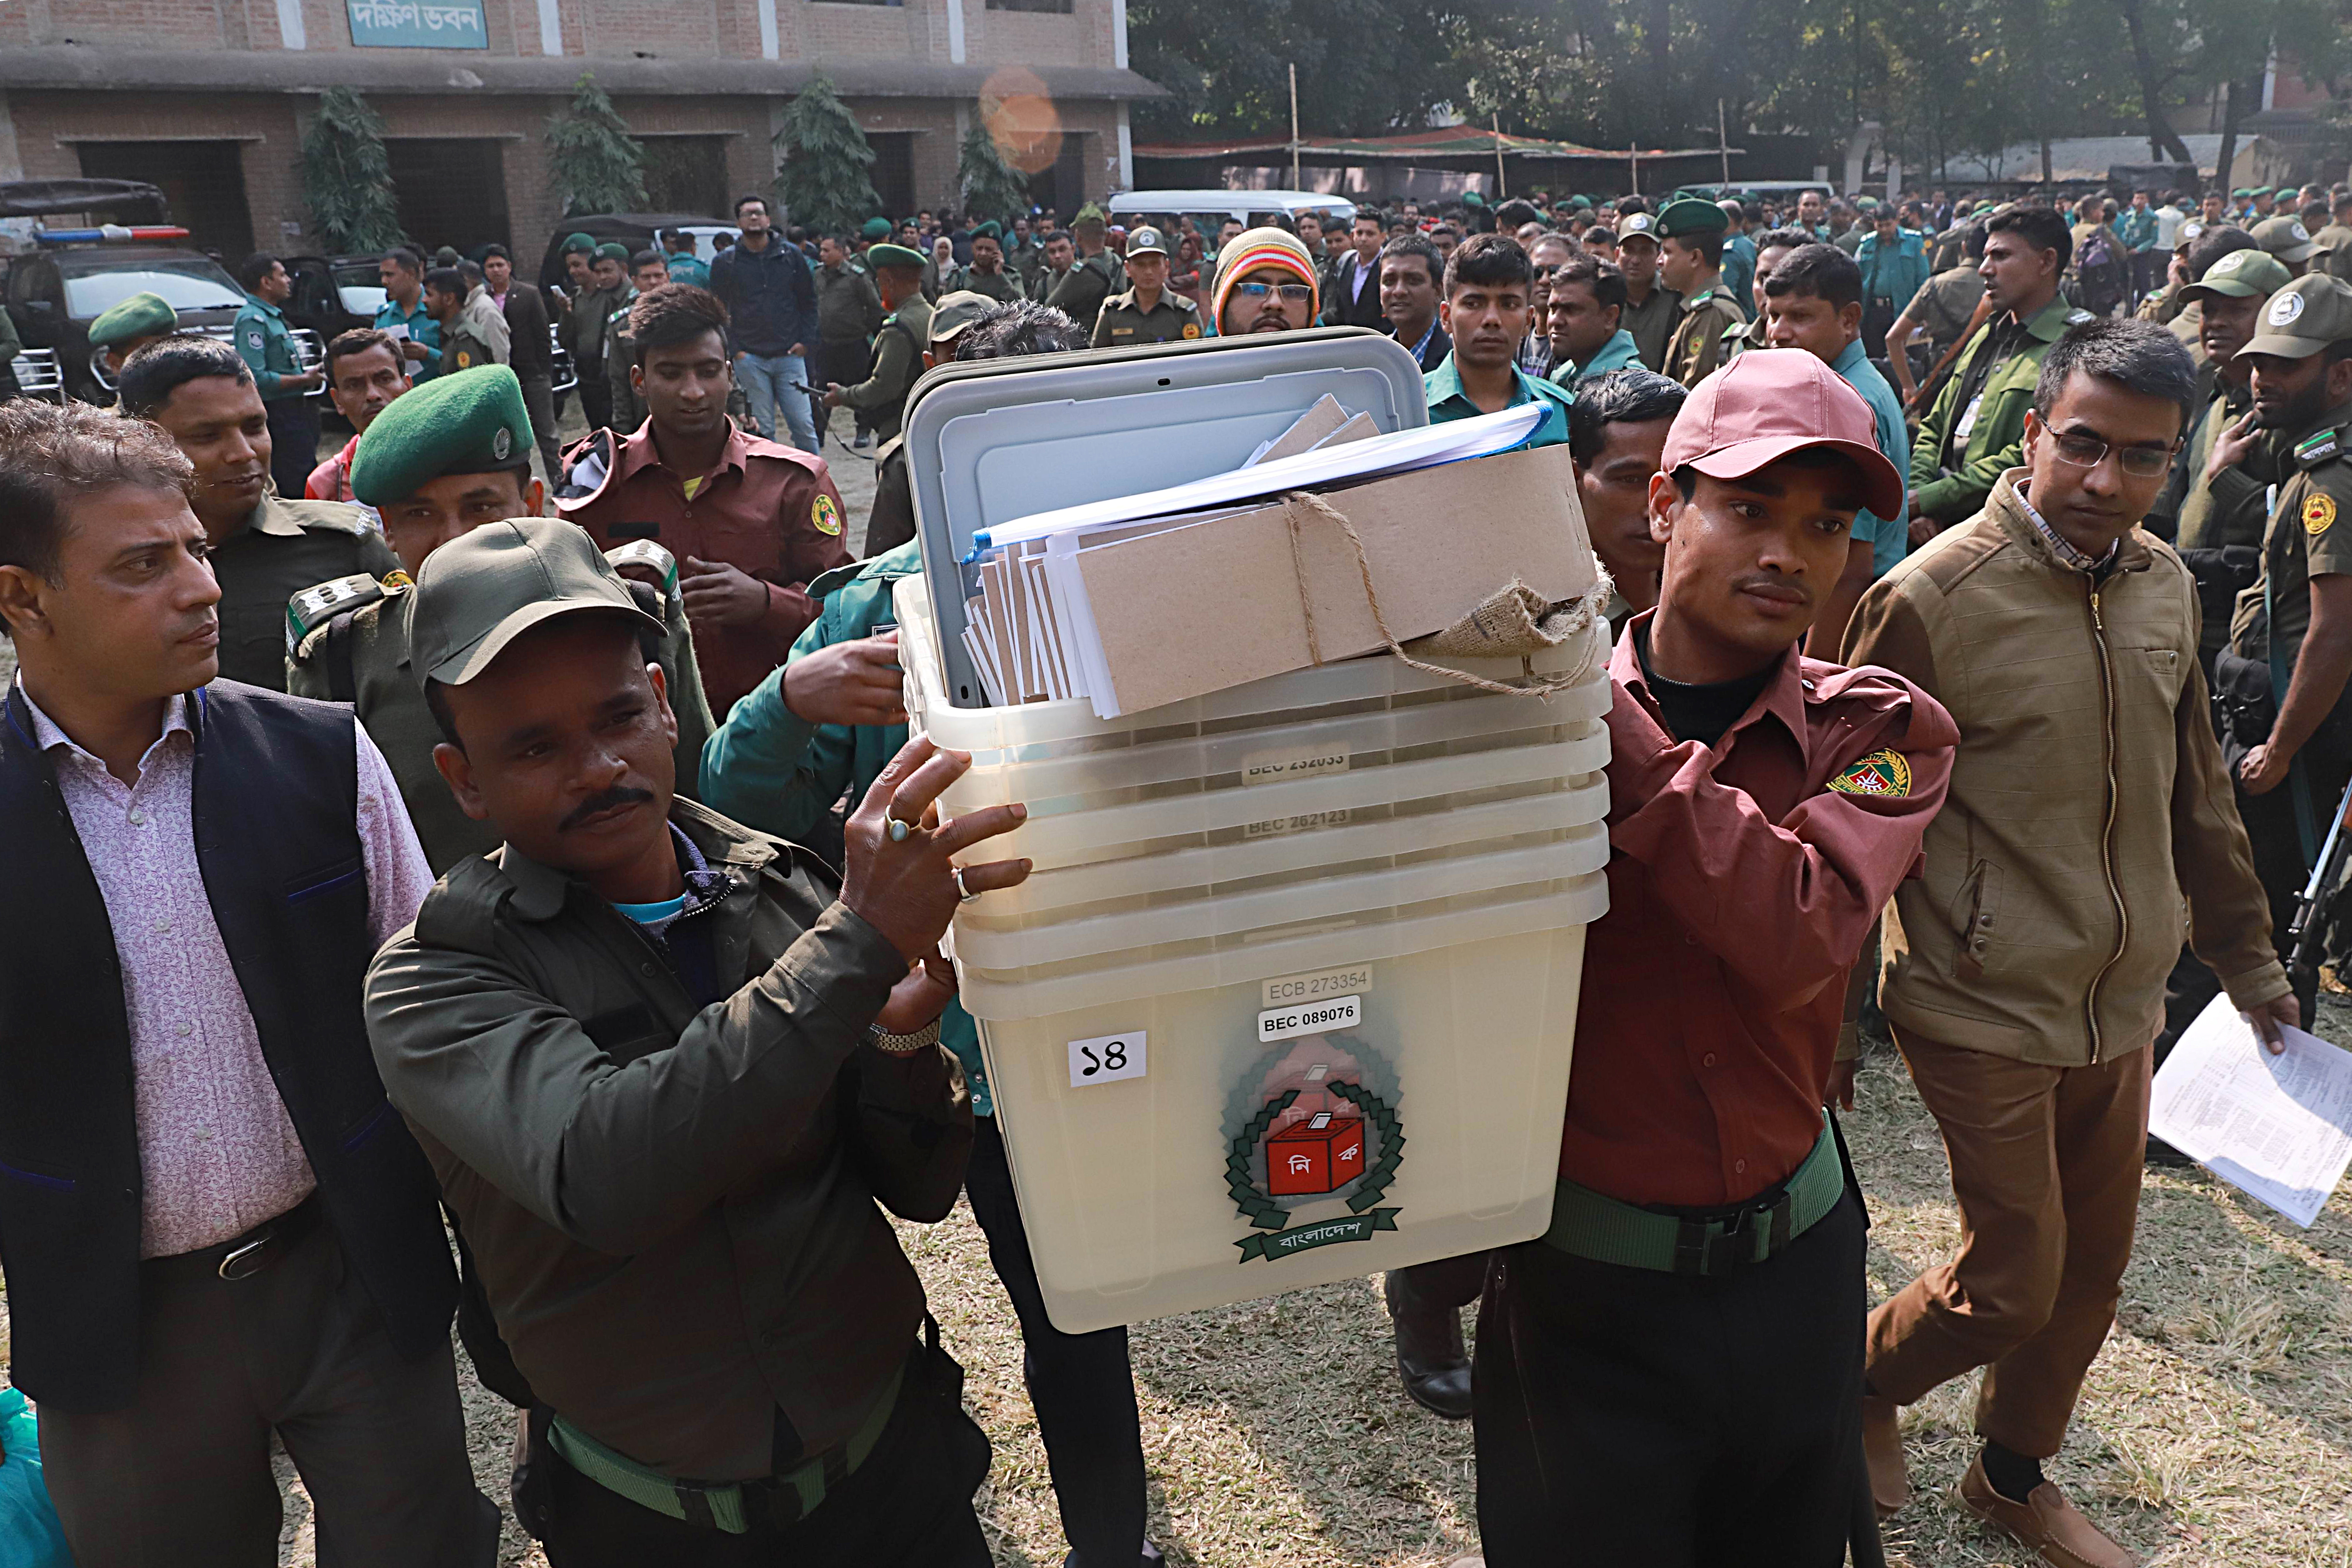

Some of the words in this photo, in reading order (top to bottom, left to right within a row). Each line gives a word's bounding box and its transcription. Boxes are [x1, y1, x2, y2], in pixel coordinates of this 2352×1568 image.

[352, 0, 420, 29] দক্ষিণ
[421, 6, 478, 32] ভবন
[1249, 819, 1284, 834] BEC
[1290, 809, 1346, 829] 262123
[1270, 982, 1305, 999] ECB
[1311, 971, 1367, 993] 273354
[1264, 1016, 1297, 1032] BEC
[1302, 1005, 1354, 1025] 089076
[1081, 1041, 1127, 1076] ১৪
[1288, 1154, 1312, 1175] নি
[1338, 1143, 1359, 1161] ক
[1279, 1222, 1362, 1248] বাংলাদেশ
